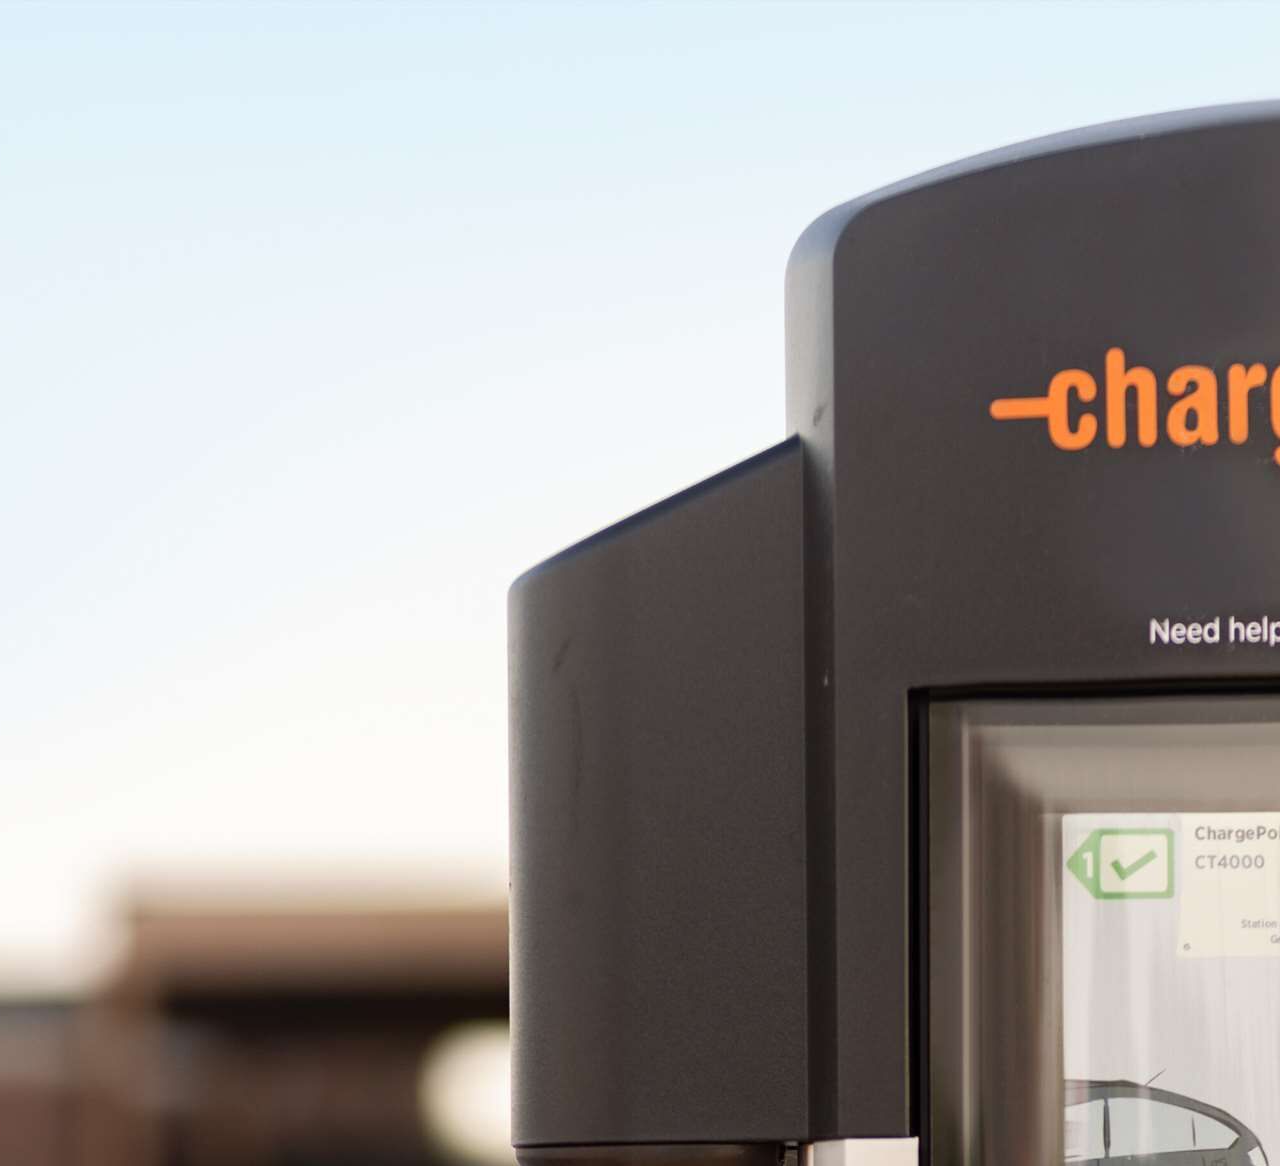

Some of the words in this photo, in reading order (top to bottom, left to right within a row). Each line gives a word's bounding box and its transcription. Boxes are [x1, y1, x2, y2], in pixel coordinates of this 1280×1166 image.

[1149, 617, 1220, 644] Need
[1082, 851, 1094, 880] 1
[1194, 854, 1266, 870] CT4000
[1241, 918, 1278, 929] Station
